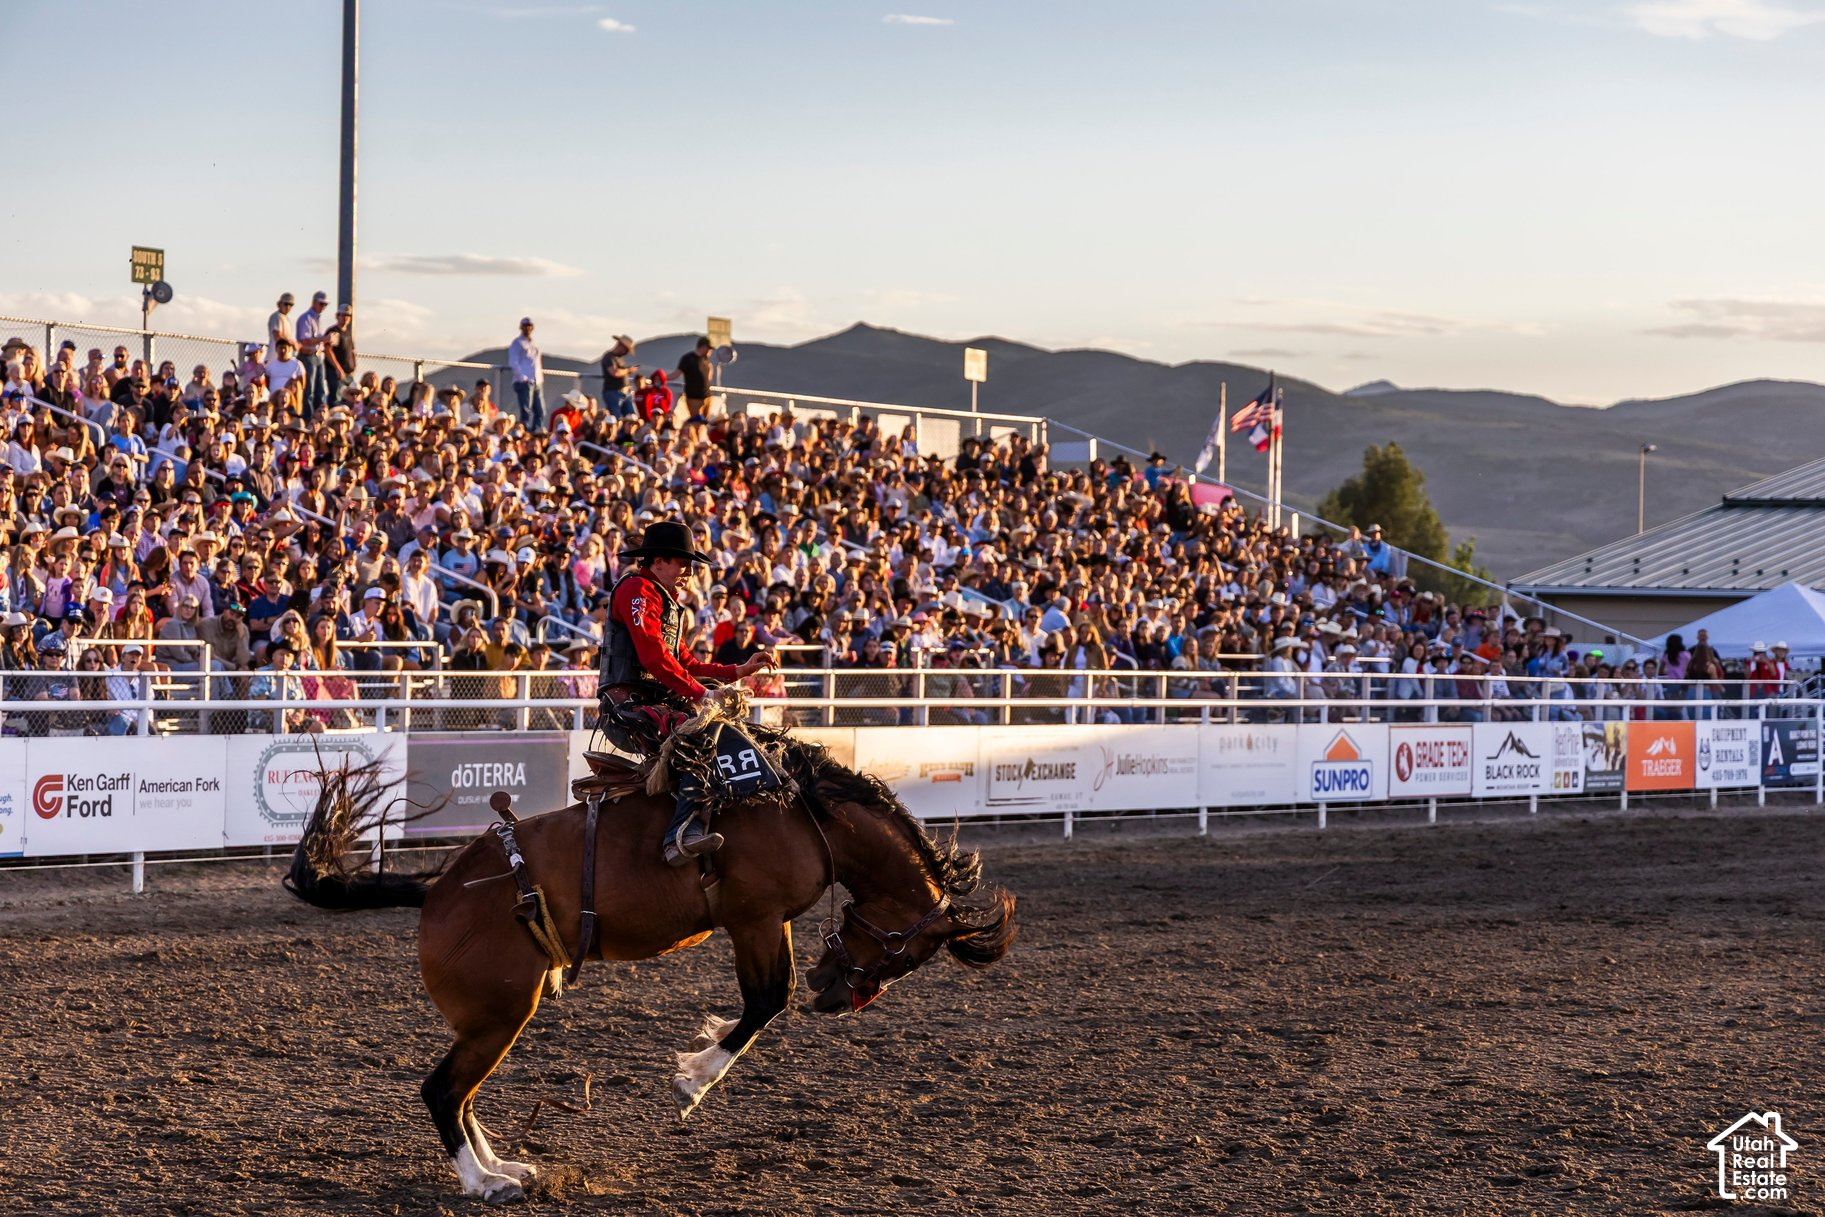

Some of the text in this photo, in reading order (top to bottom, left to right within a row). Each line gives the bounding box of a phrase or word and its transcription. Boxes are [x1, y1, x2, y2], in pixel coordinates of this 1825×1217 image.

[133, 250, 157, 265] SOUTH
[1712, 728, 1747, 741] EQUIPMENT
[1416, 741, 1468, 768] GRADE TECH
[1716, 749, 1744, 763] RENTALS
[996, 764, 1024, 782] STOCK
[1031, 762, 1076, 781] EXCHANGE
[1486, 764, 1541, 779] BLACK ROCK
[1641, 759, 1682, 776] TRAEGER
[67, 773, 130, 791] Ken Garff
[139, 777, 220, 793] American Fork
[1314, 768, 1370, 792] SUNPRO
[67, 794, 112, 818] Ford
[140, 797, 192, 809] we hear you
